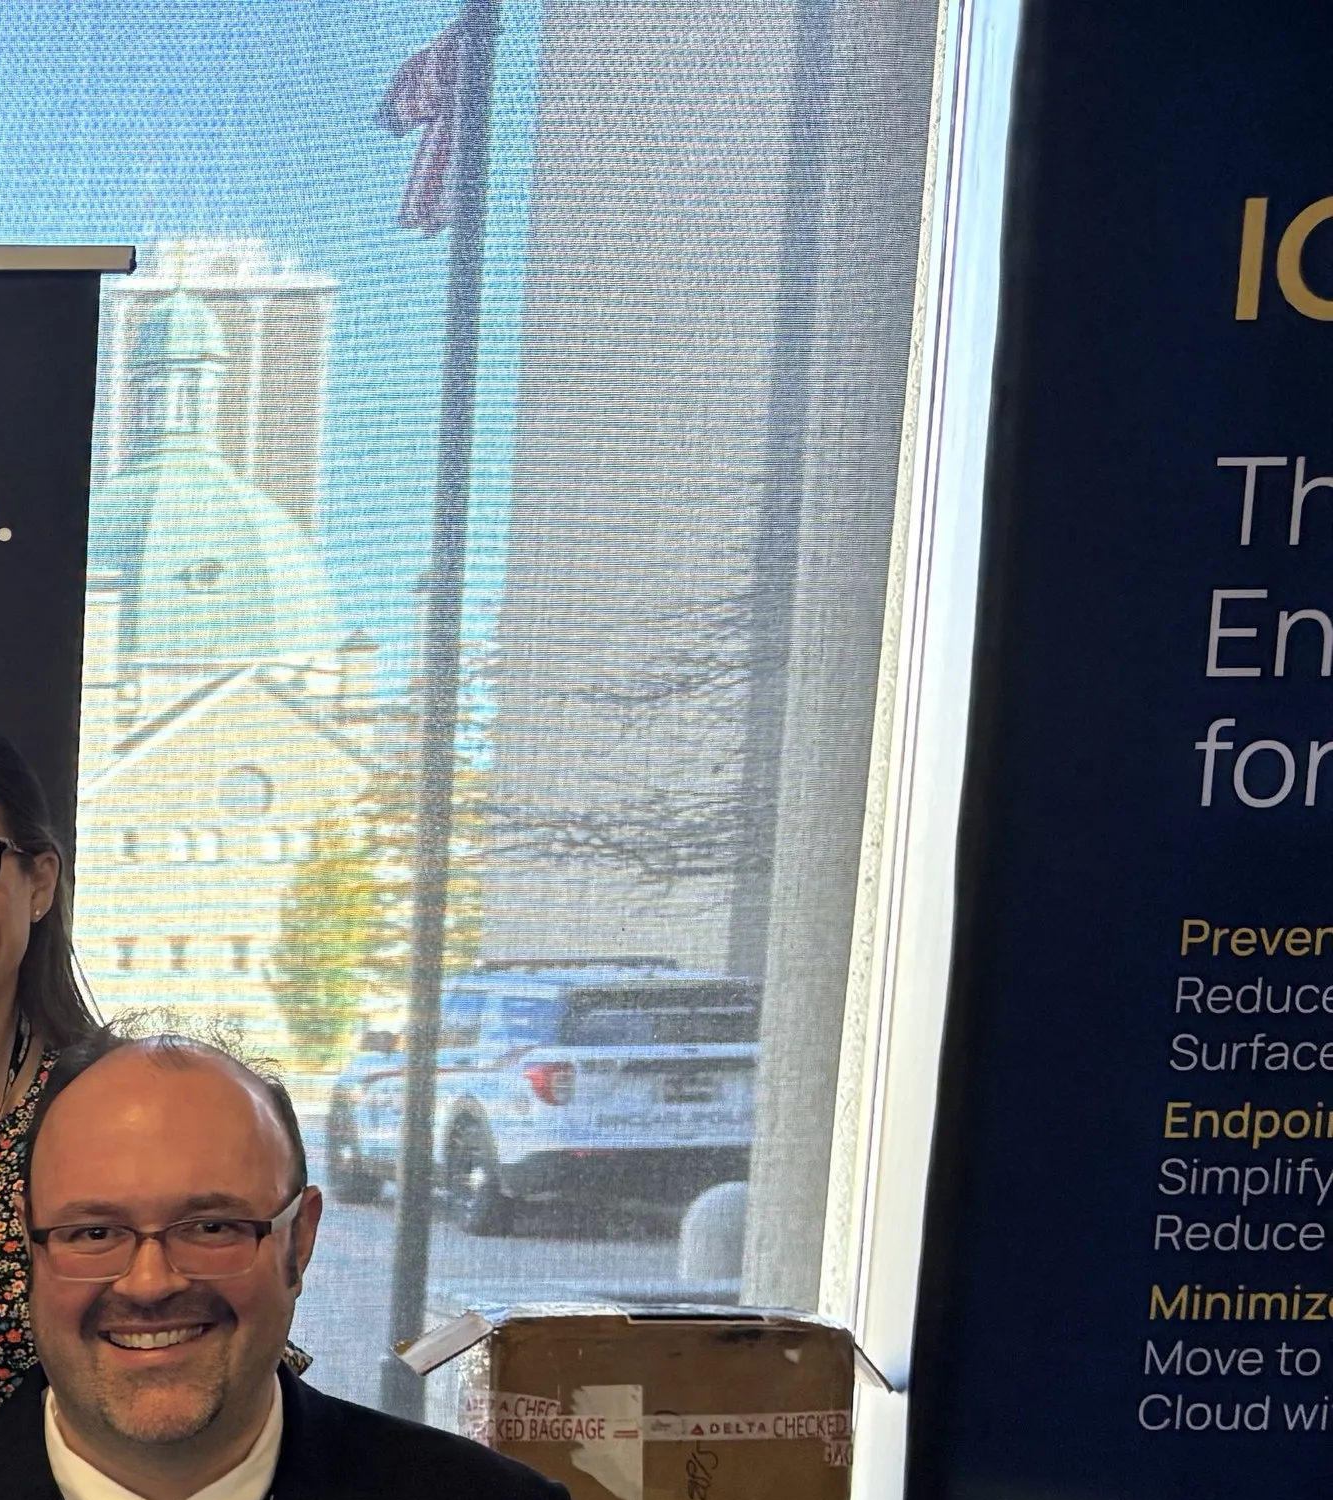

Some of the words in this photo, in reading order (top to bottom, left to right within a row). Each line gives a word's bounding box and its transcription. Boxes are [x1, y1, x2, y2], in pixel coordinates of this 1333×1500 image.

[1206, 589, 1333, 677] En
[1195, 717, 1333, 808] for
[1169, 1033, 1333, 1071] Surface
[1158, 1158, 1333, 1206] Simplify
[1154, 1214, 1324, 1252] Reduce
[1144, 1340, 1264, 1376] Move
[1276, 1341, 1321, 1376] to
[529, 1417, 606, 1441] BAGGAGE
[710, 1424, 767, 1434] DELTA
[773, 1414, 848, 1438] CHECKED
[1138, 1394, 1269, 1430] Cloud
[1283, 1395, 1333, 1430] wi
